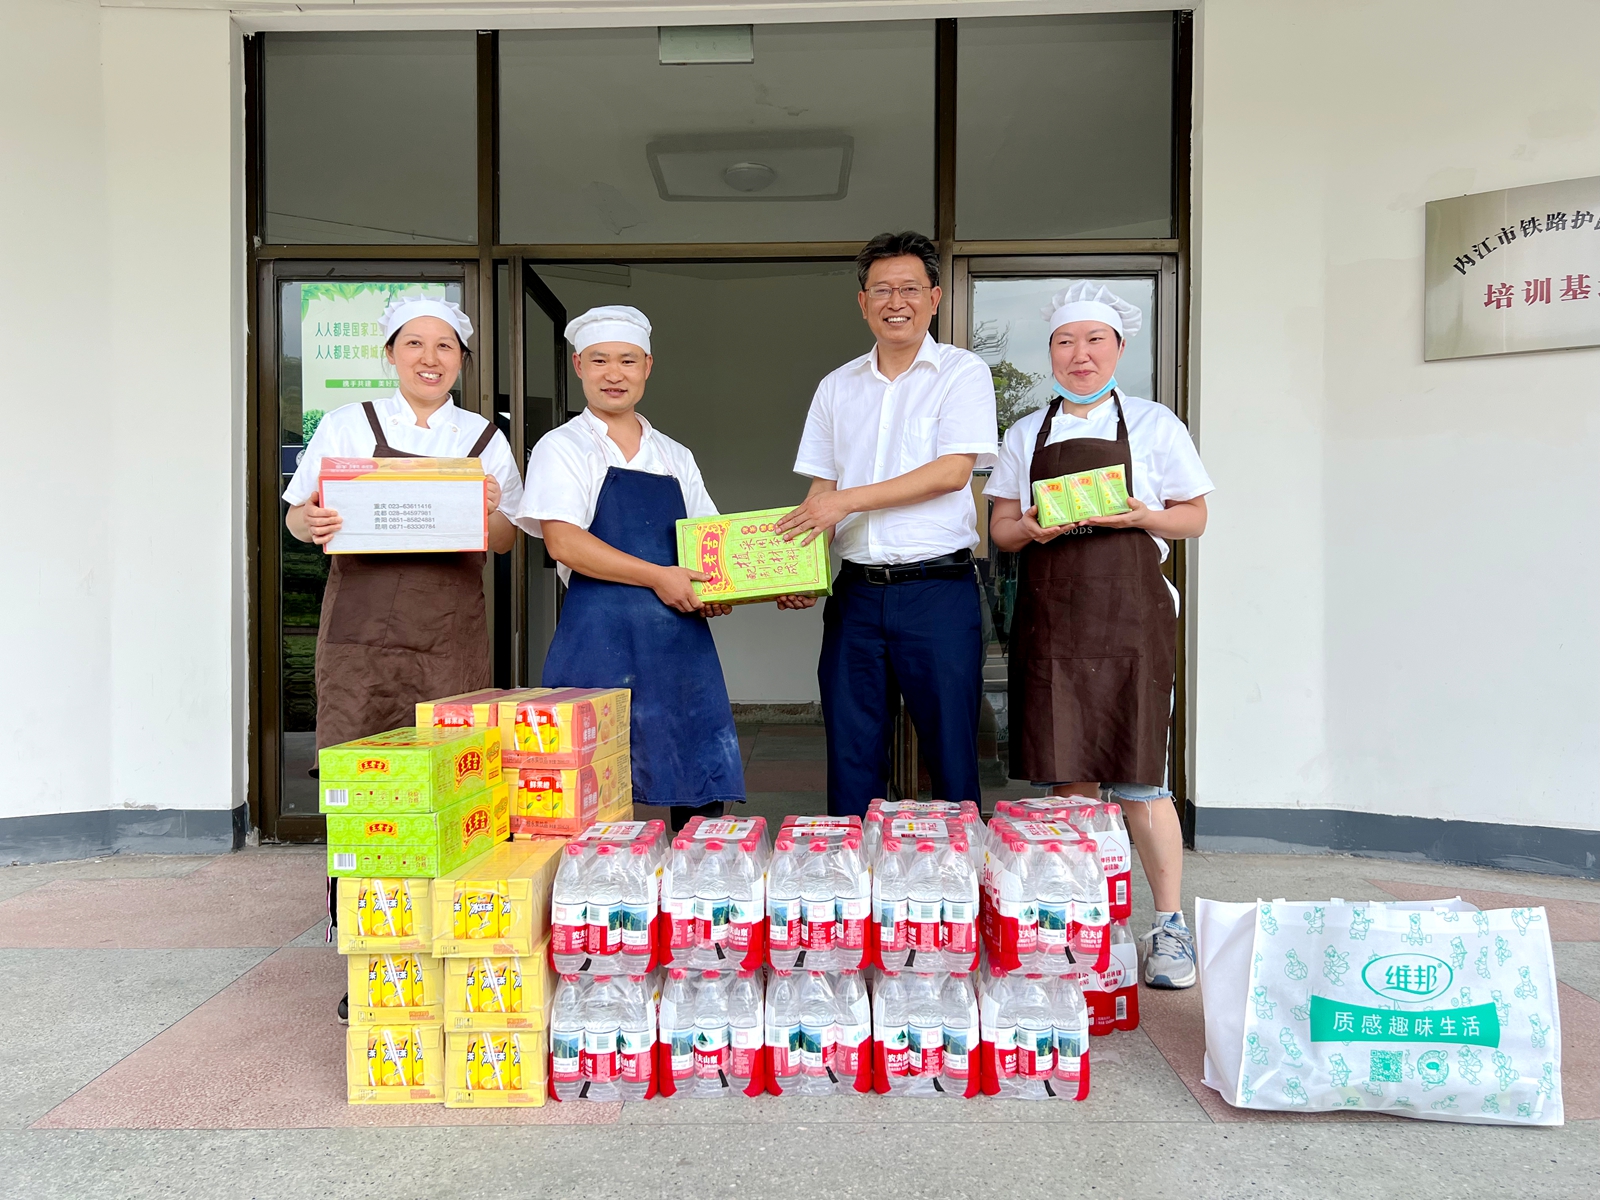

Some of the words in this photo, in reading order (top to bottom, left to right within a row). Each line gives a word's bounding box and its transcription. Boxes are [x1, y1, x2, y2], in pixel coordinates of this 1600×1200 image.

[1483, 273, 1600, 310] 培训基
[1385, 964, 1437, 992] 维邦
[1332, 1010, 1481, 1038] 质感趣味生活
